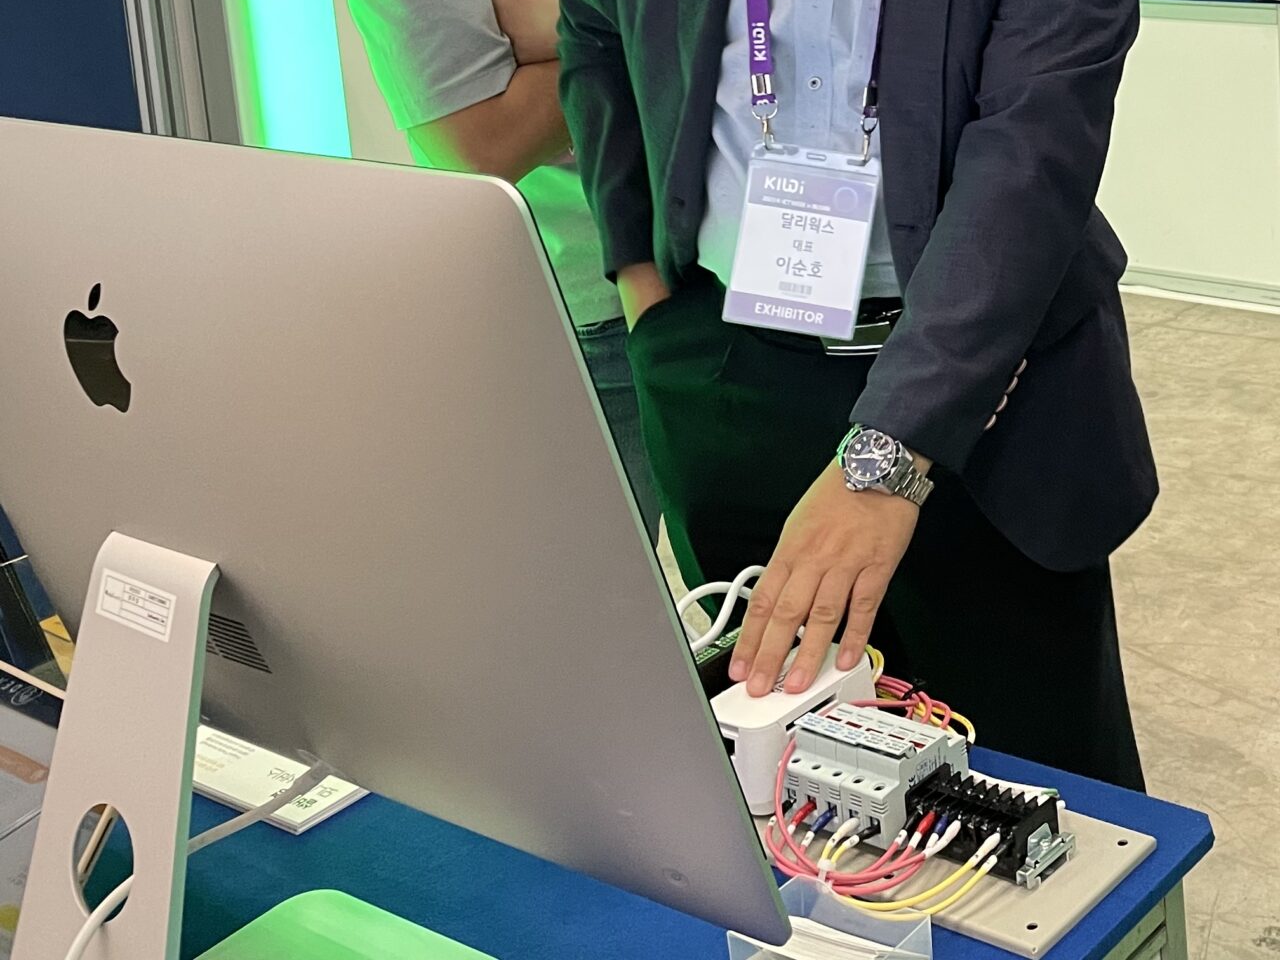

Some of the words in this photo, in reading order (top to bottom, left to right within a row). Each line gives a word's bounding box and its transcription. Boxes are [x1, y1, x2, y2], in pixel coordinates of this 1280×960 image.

[781, 212, 835, 234] 달리웍스
[792, 239, 814, 253] 대표
[776, 256, 823, 279] 이순호
[754, 302, 824, 325] EXHIBITOR
